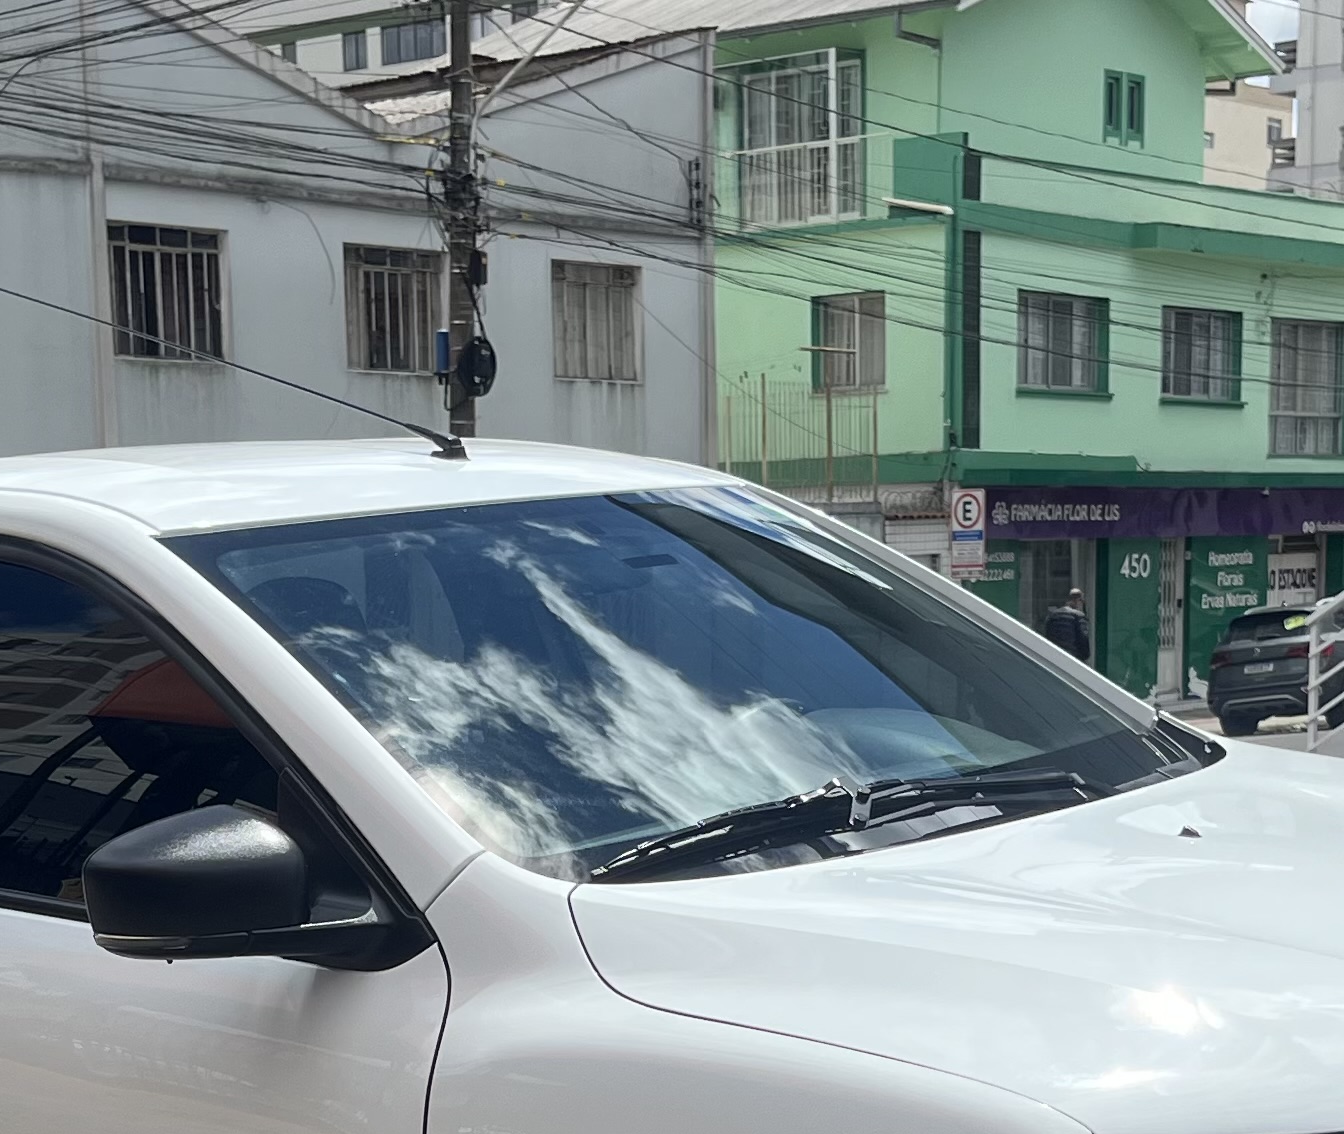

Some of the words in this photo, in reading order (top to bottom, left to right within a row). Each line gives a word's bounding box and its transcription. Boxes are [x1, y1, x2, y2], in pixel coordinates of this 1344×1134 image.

[962, 501, 973, 522] E
[1063, 503, 1089, 521] FLOR
[1090, 504, 1103, 521] DE
[1105, 503, 1121, 522] LIS
[1120, 552, 1151, 580] 450
